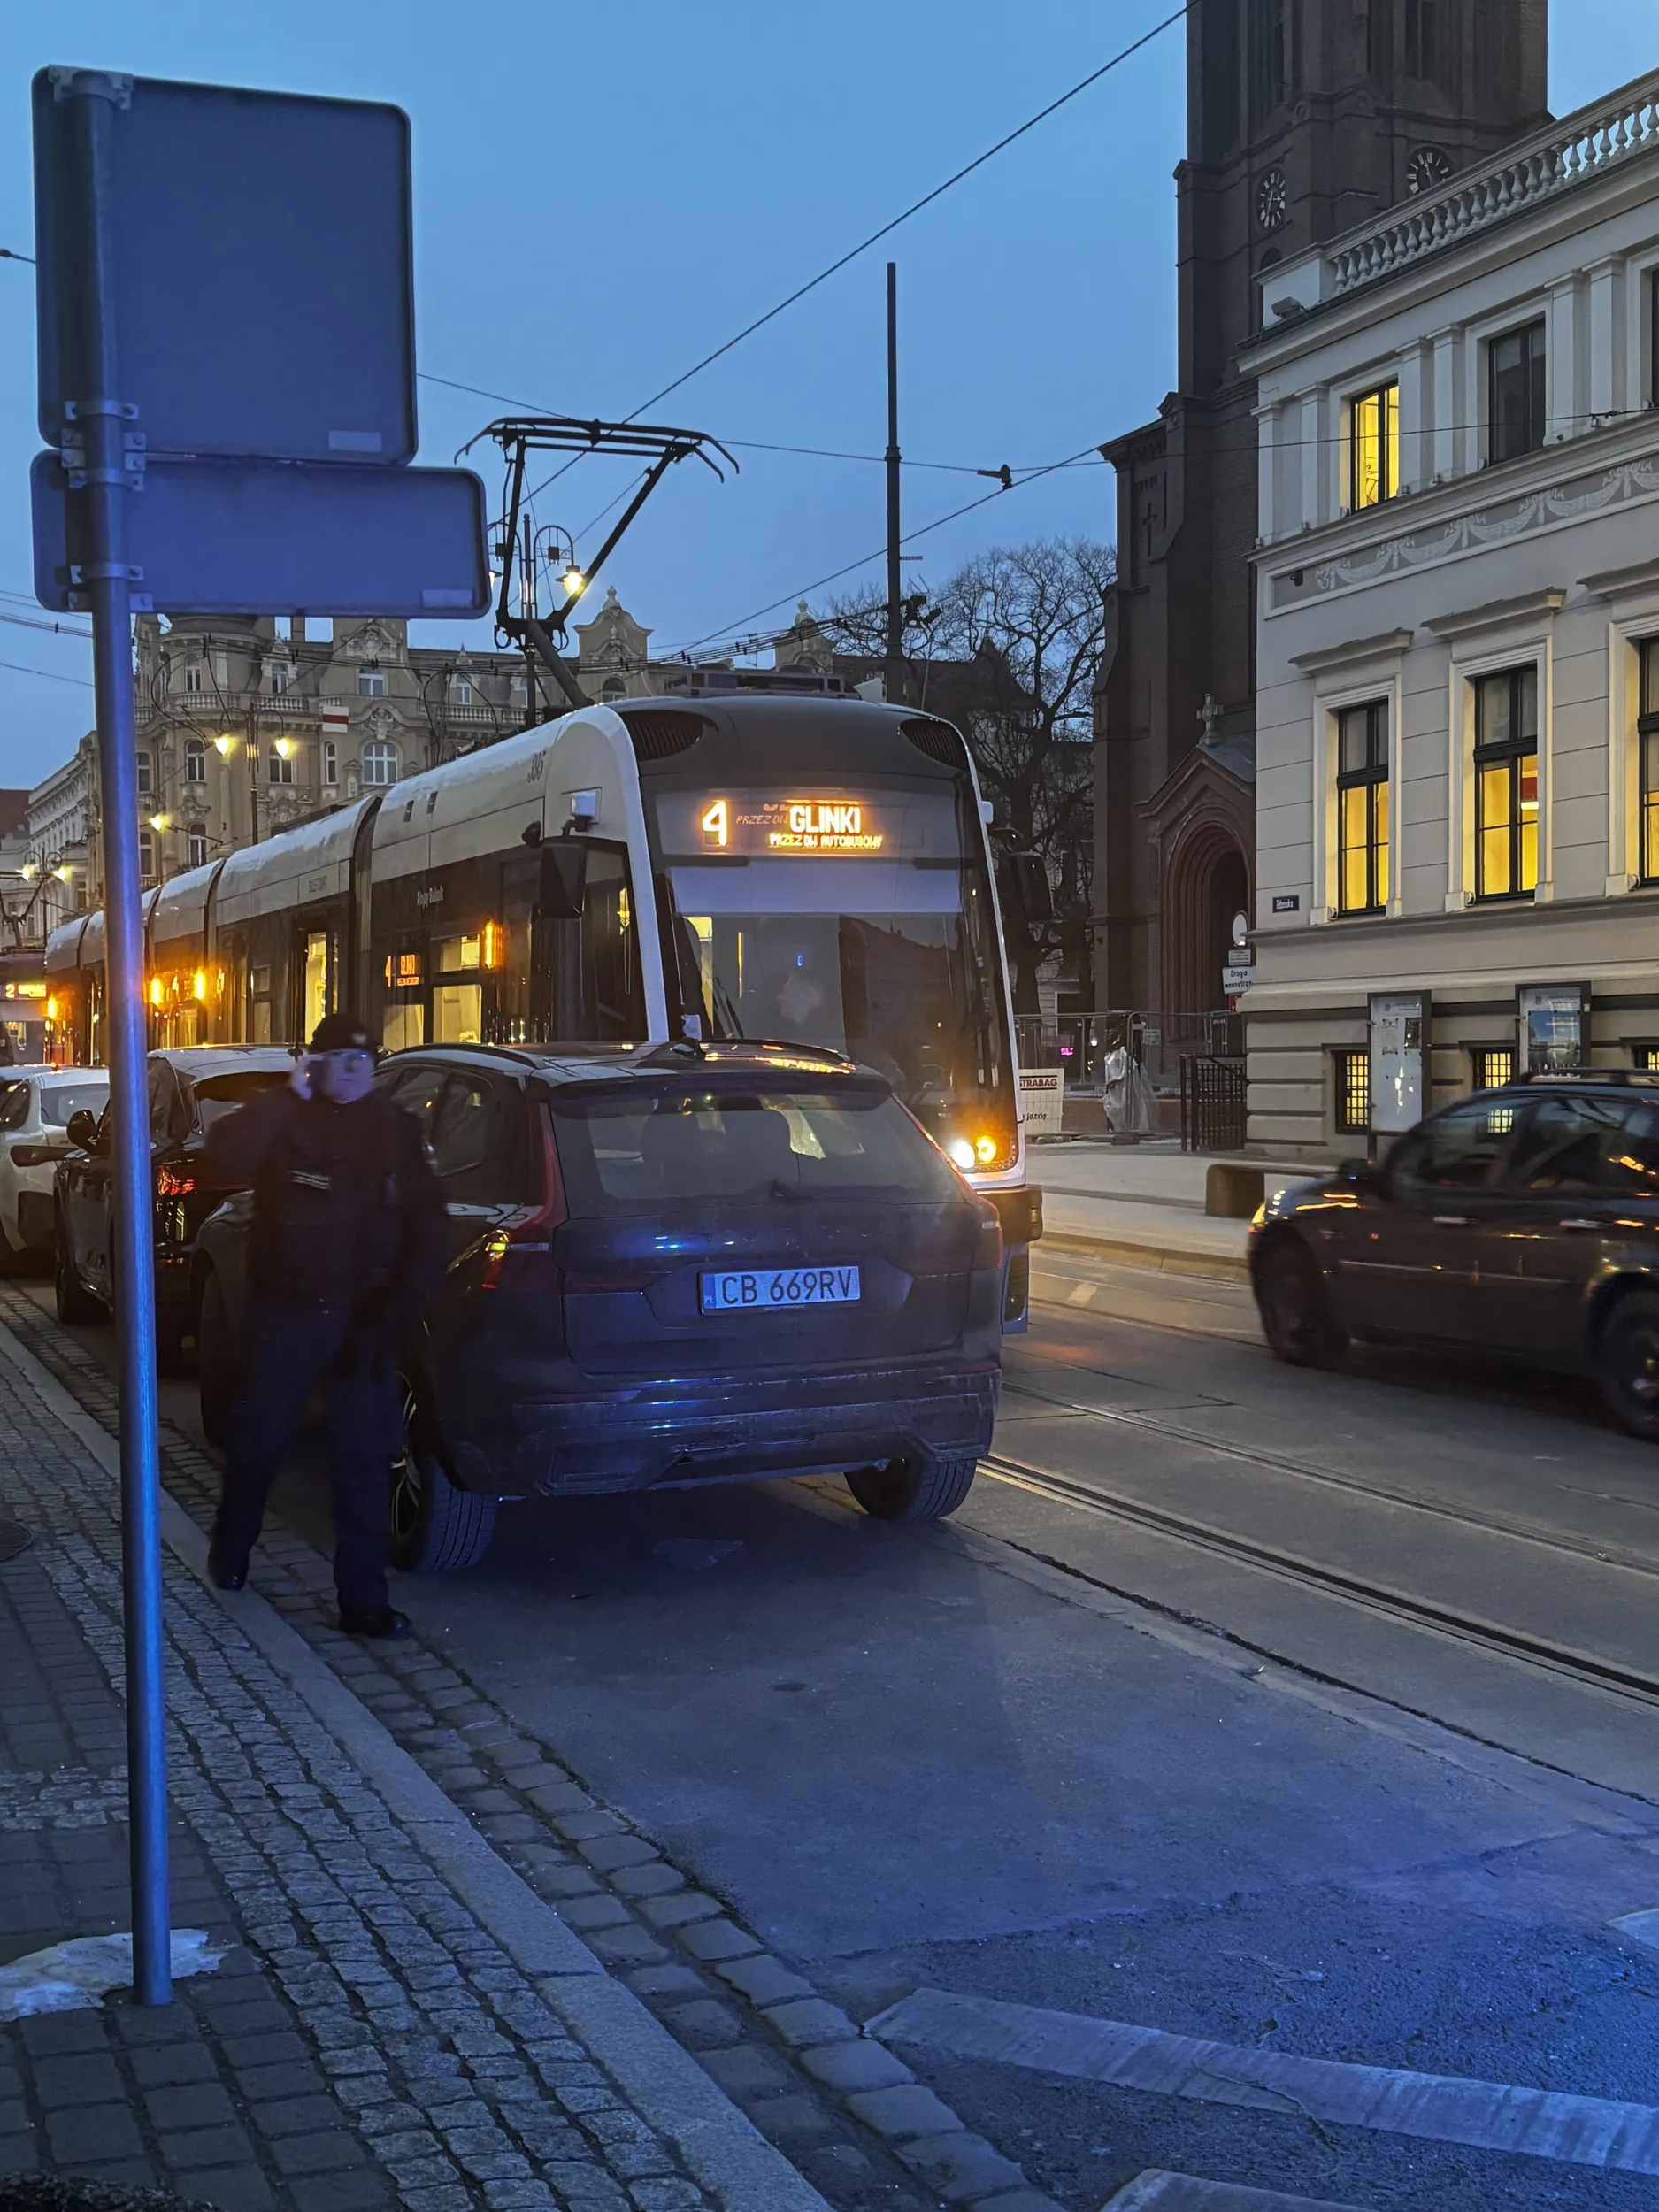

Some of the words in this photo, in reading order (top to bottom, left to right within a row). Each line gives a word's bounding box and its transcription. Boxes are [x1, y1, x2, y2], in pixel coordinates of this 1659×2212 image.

[702, 801, 727, 846] 4
[789, 805, 861, 833] GLINKI
[769, 833, 803, 847] PRZEZ
[385, 956, 392, 987] 4
[5, 983, 15, 998] 2
[721, 1274, 758, 1304] CB
[769, 1270, 852, 1302] 669RV
